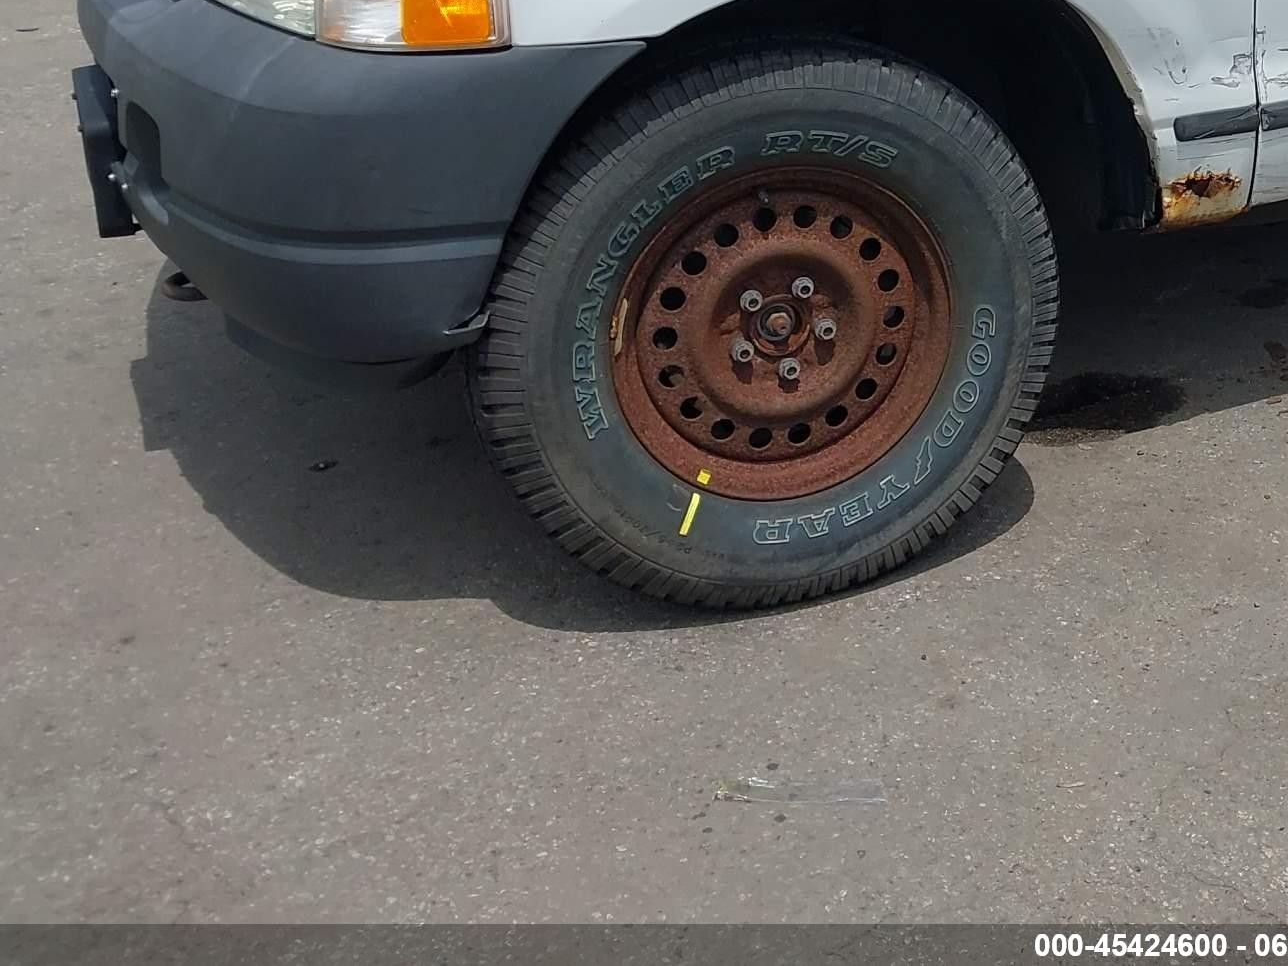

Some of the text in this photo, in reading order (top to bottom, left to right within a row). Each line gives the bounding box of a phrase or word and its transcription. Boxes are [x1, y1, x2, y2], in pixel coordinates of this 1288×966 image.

[571, 129, 899, 441] WRANGLER RT/S
[751, 305, 997, 545] GOODYEAR
